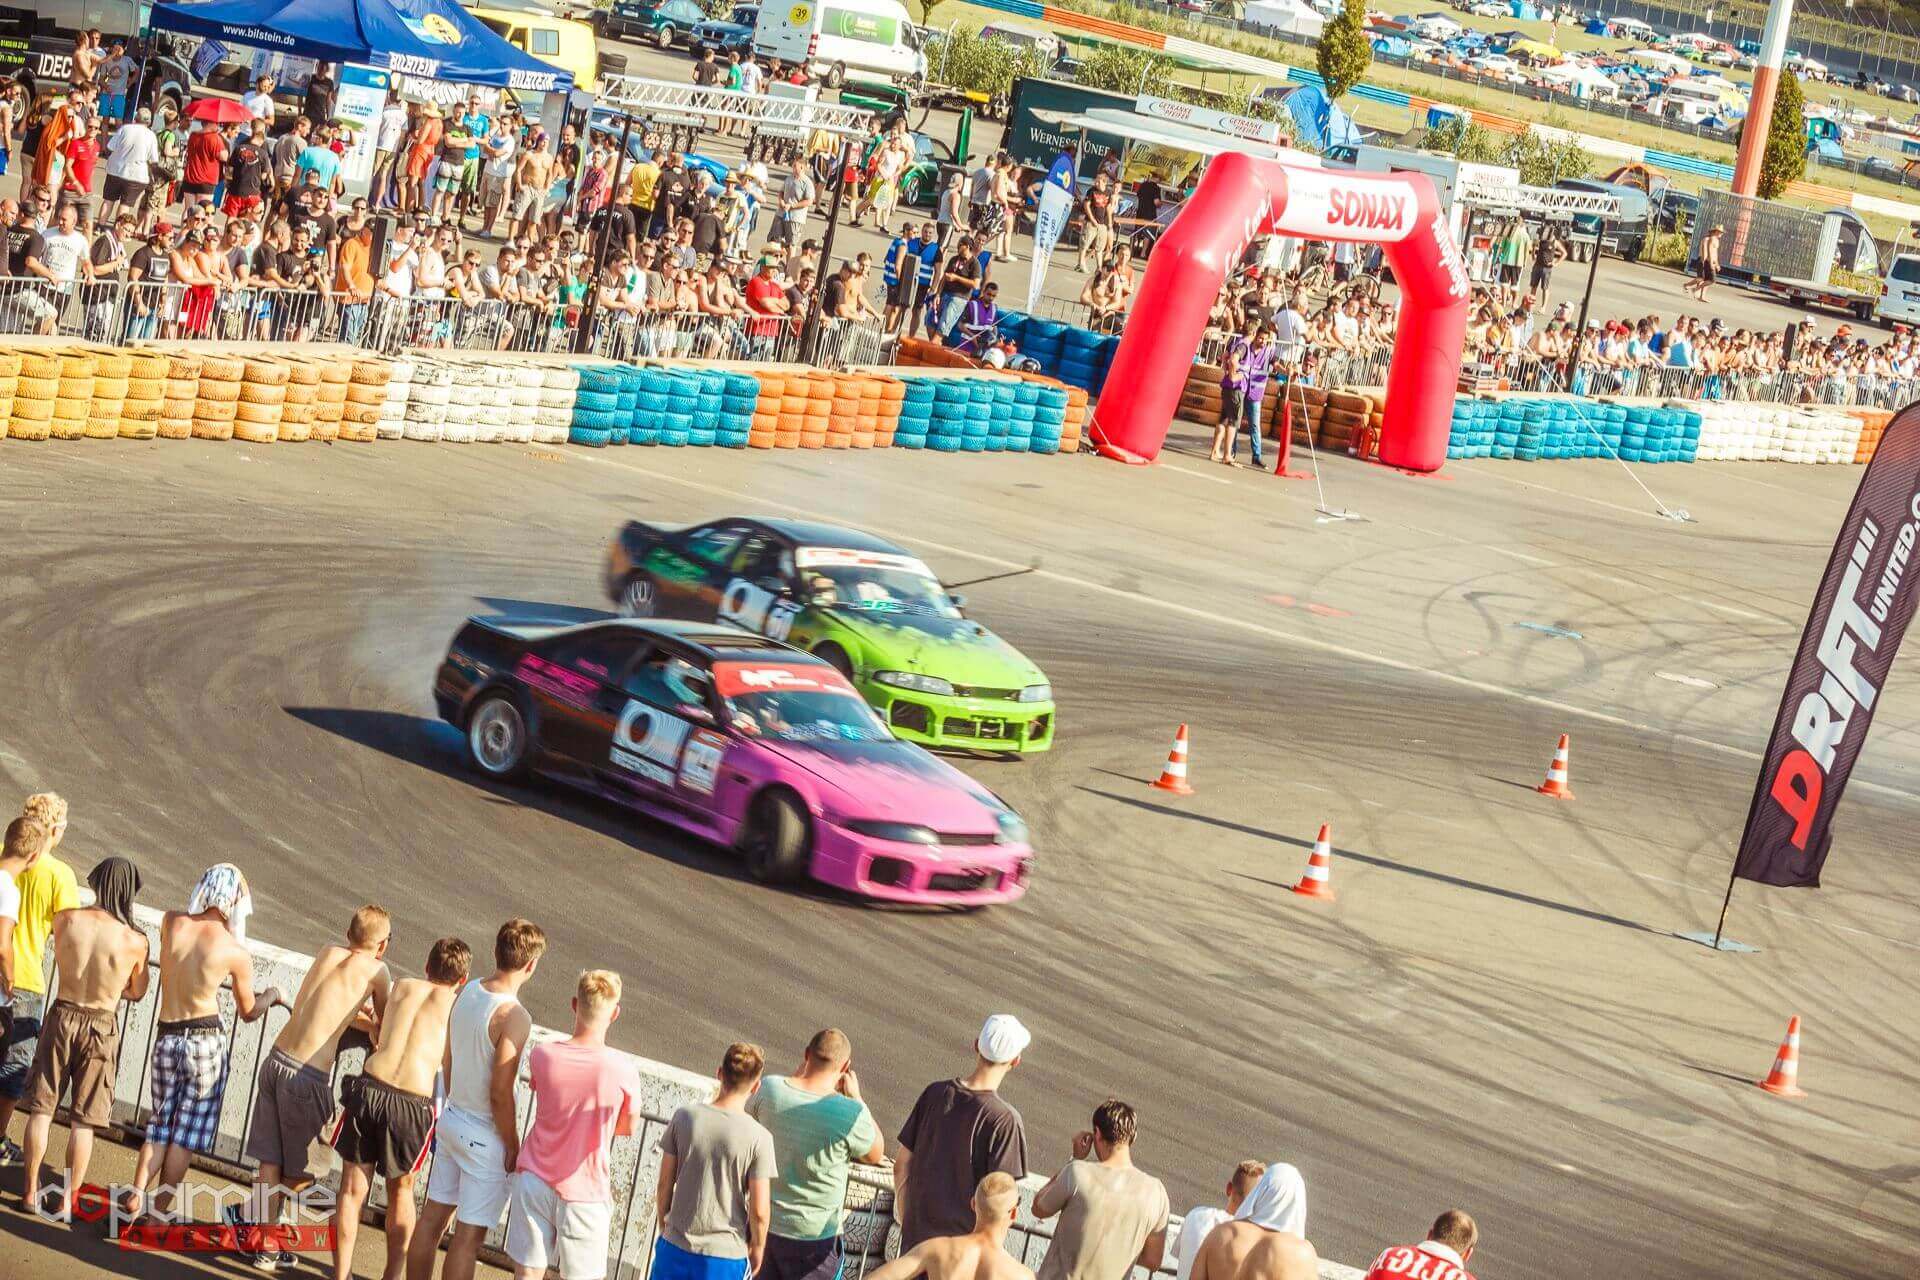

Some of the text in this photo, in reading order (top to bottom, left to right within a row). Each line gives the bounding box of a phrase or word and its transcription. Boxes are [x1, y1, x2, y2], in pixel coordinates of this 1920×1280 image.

[795, 8, 807, 19] 39
[222, 24, 296, 46] www.bilstein.de
[388, 51, 440, 77] BILSTEIN
[509, 68, 557, 91] BILSTEIN
[1030, 127, 1112, 157] WERNESGÜNER
[1327, 188, 1405, 230] SONAX
[1770, 517, 1882, 851] DRIFT
